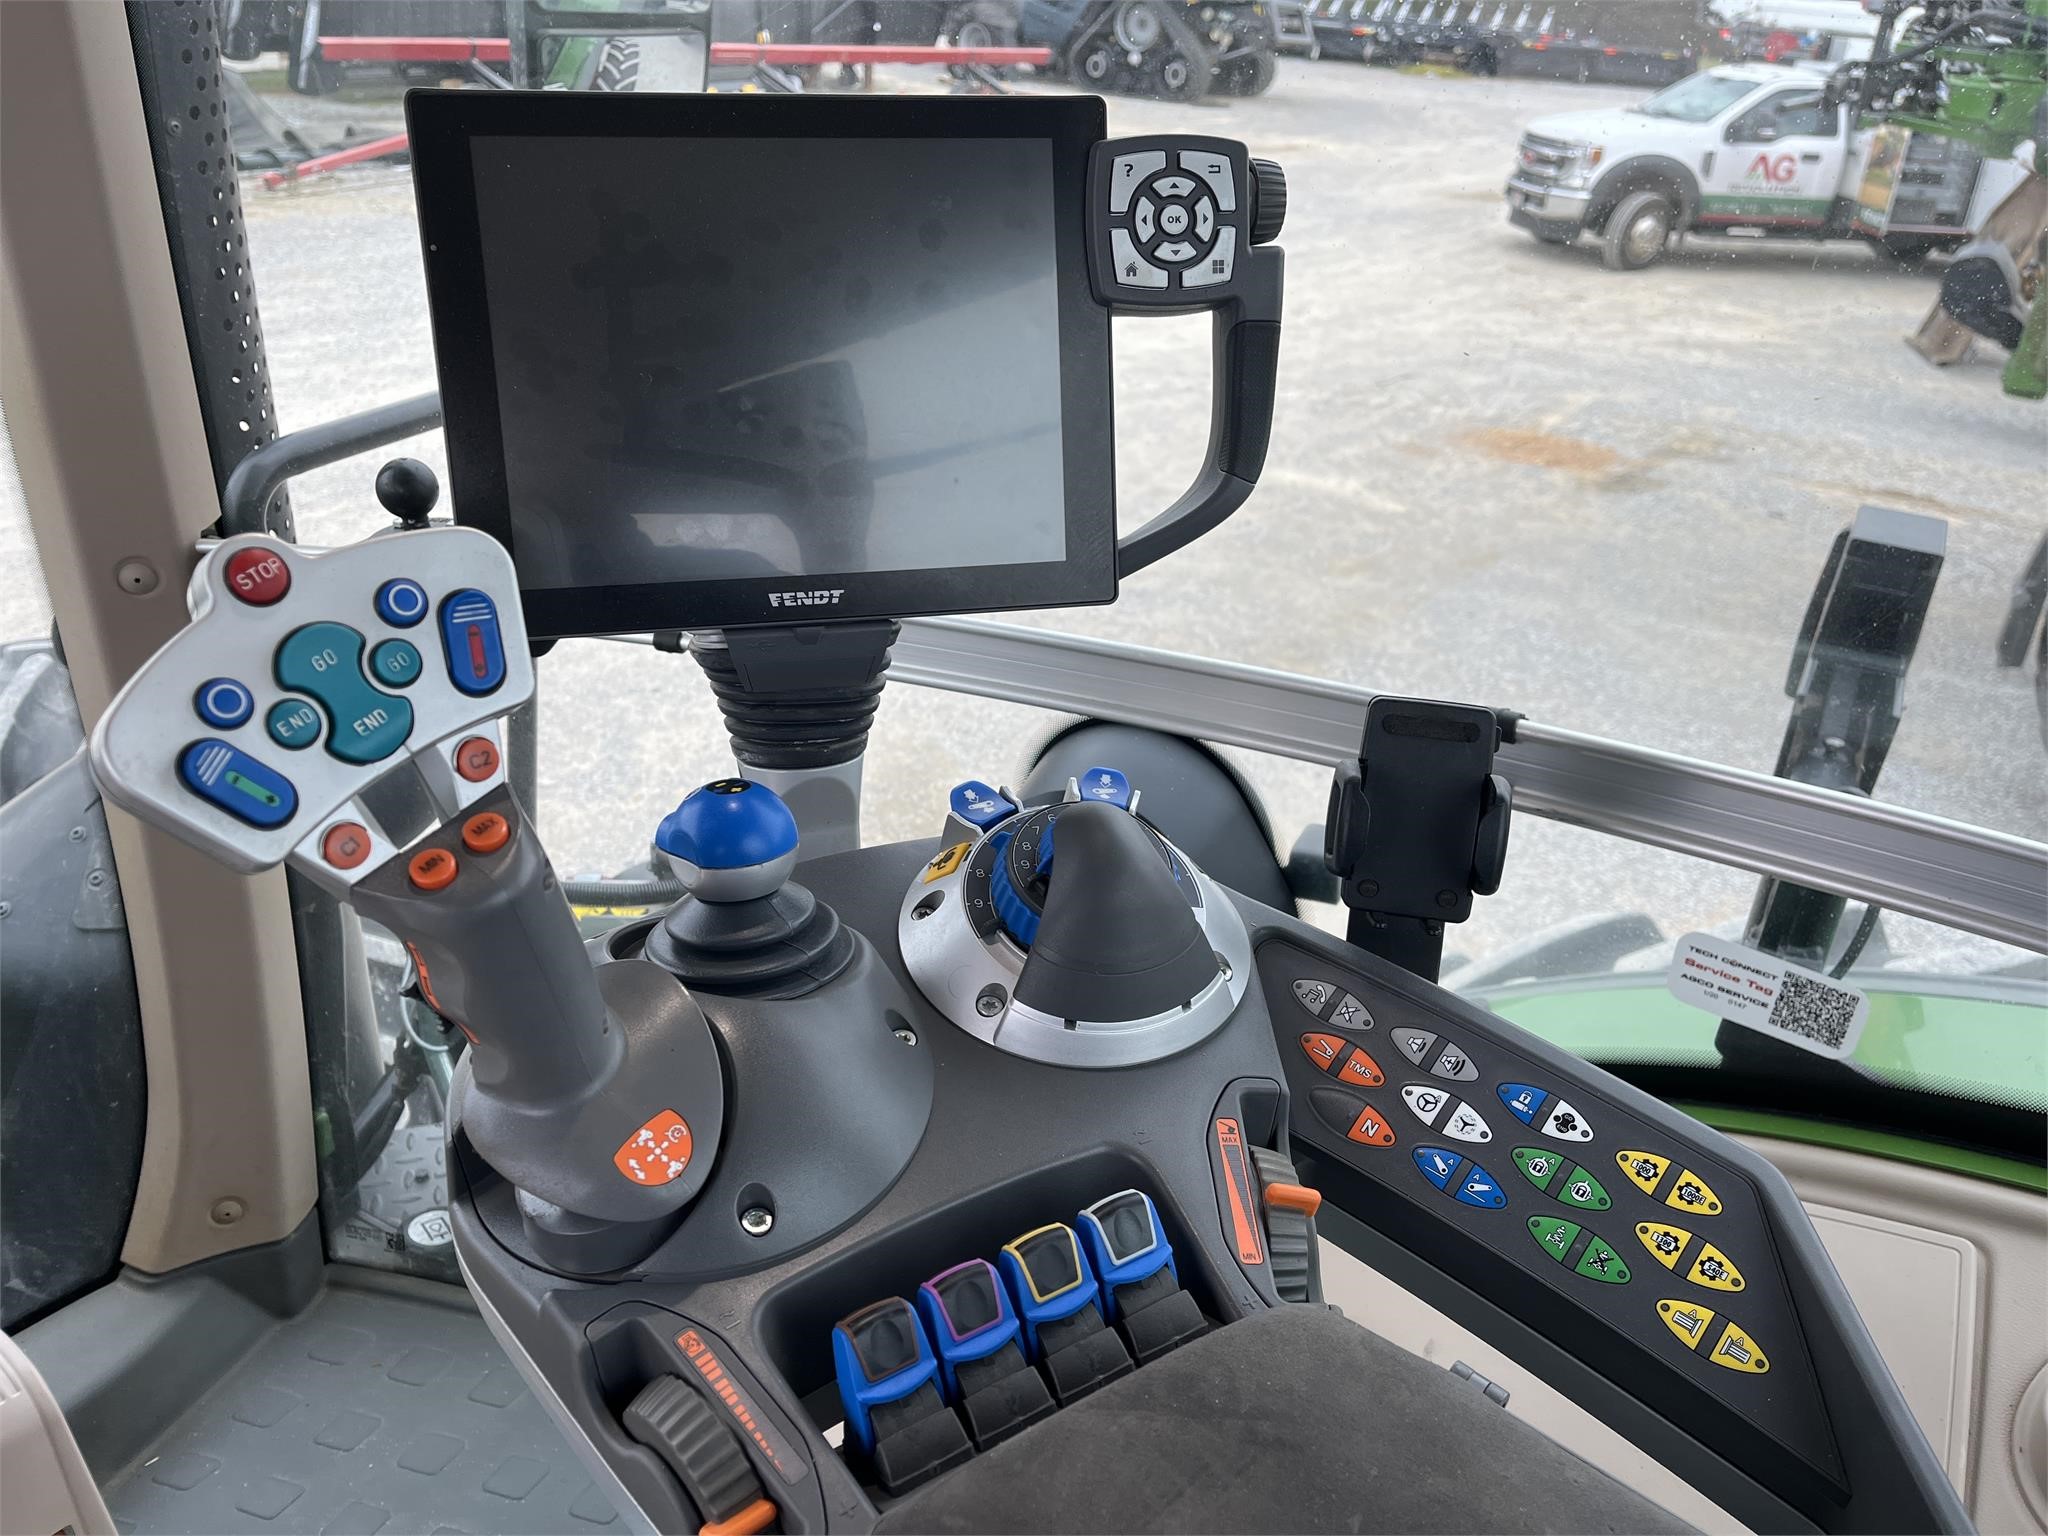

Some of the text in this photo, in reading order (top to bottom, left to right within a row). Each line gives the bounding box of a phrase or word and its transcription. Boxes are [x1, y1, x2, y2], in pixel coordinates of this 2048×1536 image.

[1124, 163, 1134, 177] ?
[1744, 152, 1797, 185] AG
[1167, 215, 1182, 225] OK
[236, 557, 282, 590] STOP
[768, 589, 845, 607] FENDT
[311, 648, 338, 672] GO
[387, 652, 409, 673] GO
[276, 708, 314, 737] END
[353, 708, 388, 736] END
[468, 750, 494, 769] C2
[471, 818, 498, 836] MAX
[1031, 826, 1040, 836] 7
[340, 836, 361, 857] C1
[1022, 841, 1032, 851] 8
[418, 854, 445, 874] MIN
[975, 868, 985, 878] 8
[1020, 860, 1030, 869] 9
[974, 898, 984, 908] 9
[1689, 945, 1779, 981] TECH CONNECT
[1684, 957, 1774, 997] Service Tag
[1680, 973, 1769, 1009] AGCO SERVICE
[1348, 1060, 1372, 1079] TMS
[1360, 1119, 1380, 1137] N
[1222, 1136, 1238, 1144] MAX
[1635, 1162, 1651, 1175] 1000
[1684, 1189, 1706, 1204] 1000E
[1655, 1235, 1672, 1248] 1300
[1242, 1252, 1257, 1261] MIN
[1707, 1264, 1725, 1278] 540E
